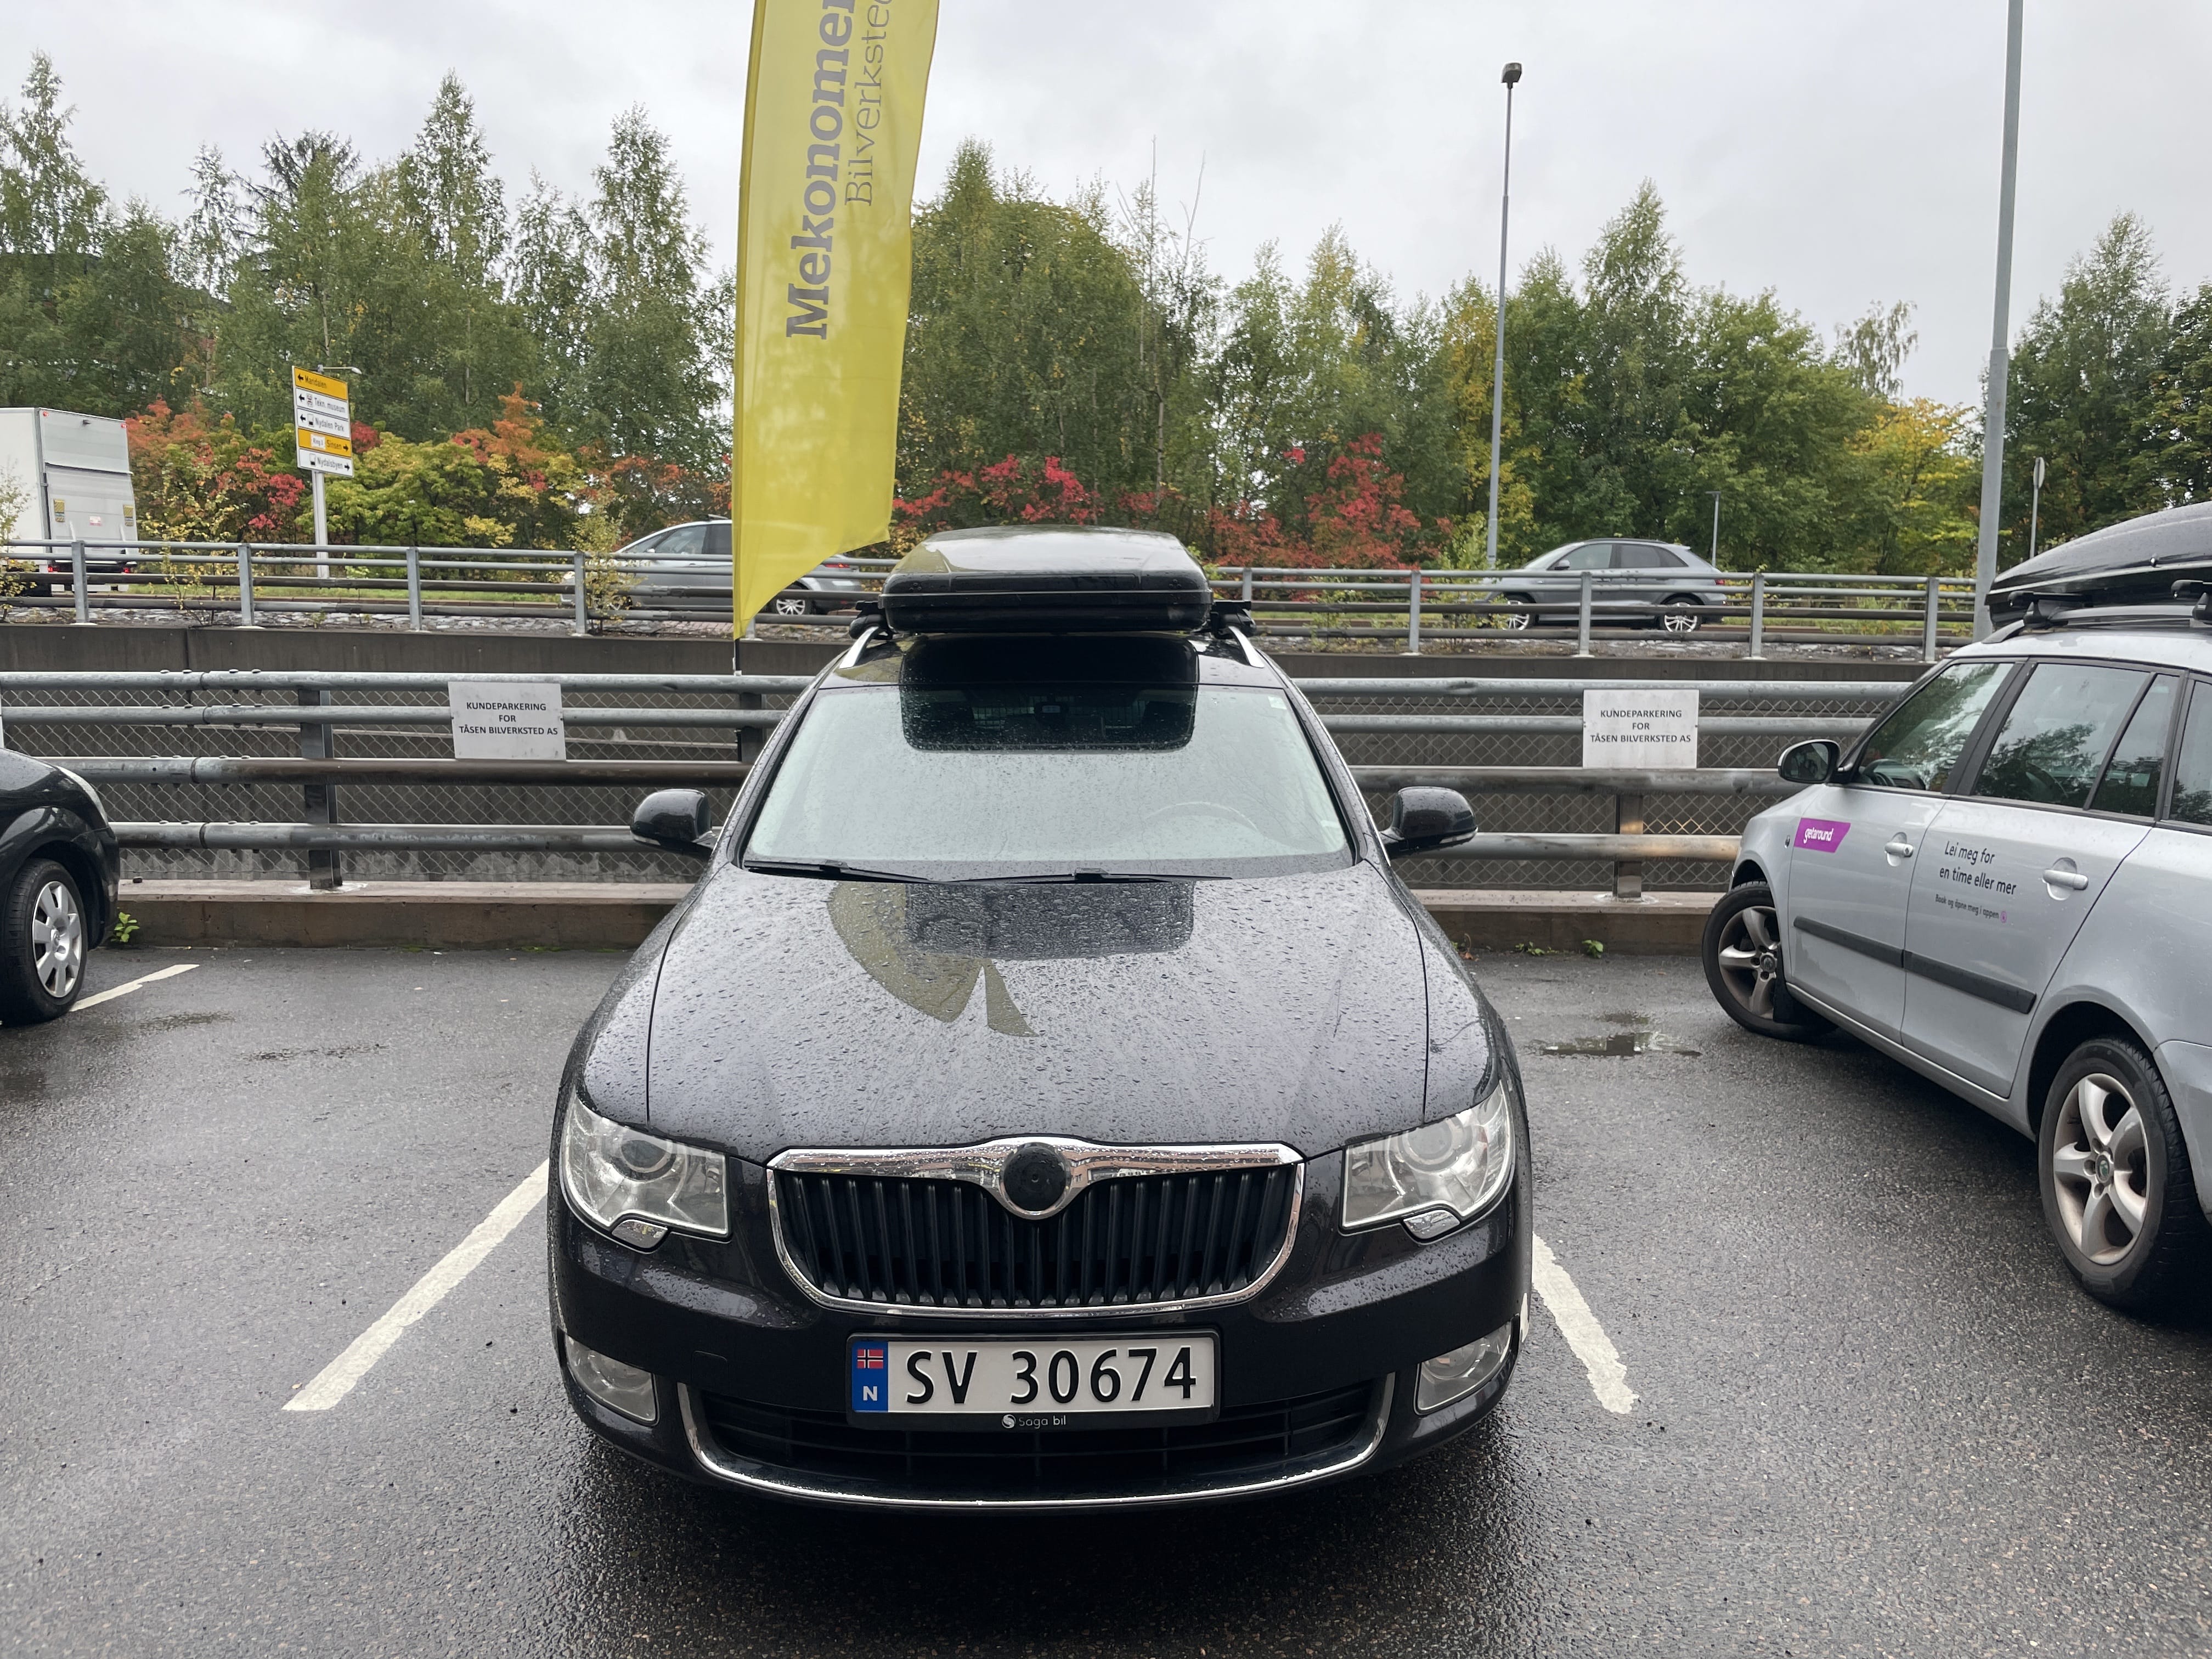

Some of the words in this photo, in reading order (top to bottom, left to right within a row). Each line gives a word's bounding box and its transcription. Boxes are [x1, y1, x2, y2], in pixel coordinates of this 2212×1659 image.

[845, 0, 894, 206] Bilverkste
[315, 417, 333, 429] Nydalen
[335, 422, 345, 431] Park
[326, 439, 342, 450] Sinsen
[466, 702, 546, 711] KUNDEPARKERING
[1600, 710, 1683, 718] KUNDEPARKERING
[459, 724, 486, 734] TÅSEN
[489, 726, 544, 735] BILVERKSTED
[1590, 732, 1618, 742] TÅSEN
[1803, 827, 1834, 844] getaround
[1944, 840, 1959, 856] Lei
[1958, 848, 1979, 865] meg
[1980, 848, 1995, 864] for
[1939, 867, 1950, 879] en
[1953, 866, 1972, 885] time
[1974, 872, 1995, 890] eller
[1996, 881, 2017, 895] mer
[1935, 894, 1947, 904] Book
[1948, 899, 1954, 909] og
[1955, 899, 1967, 910] åpne
[1967, 904, 1979, 916] meg
[1979, 906, 1982, 915] i
[1983, 910, 1999, 919] appen
[905, 1349, 978, 1405] SV
[1009, 1345, 1197, 1405] 30674
[863, 1386, 878, 1401] N
[1018, 1417, 1048, 1429] Saga
[1053, 1414, 1066, 1425] bil
